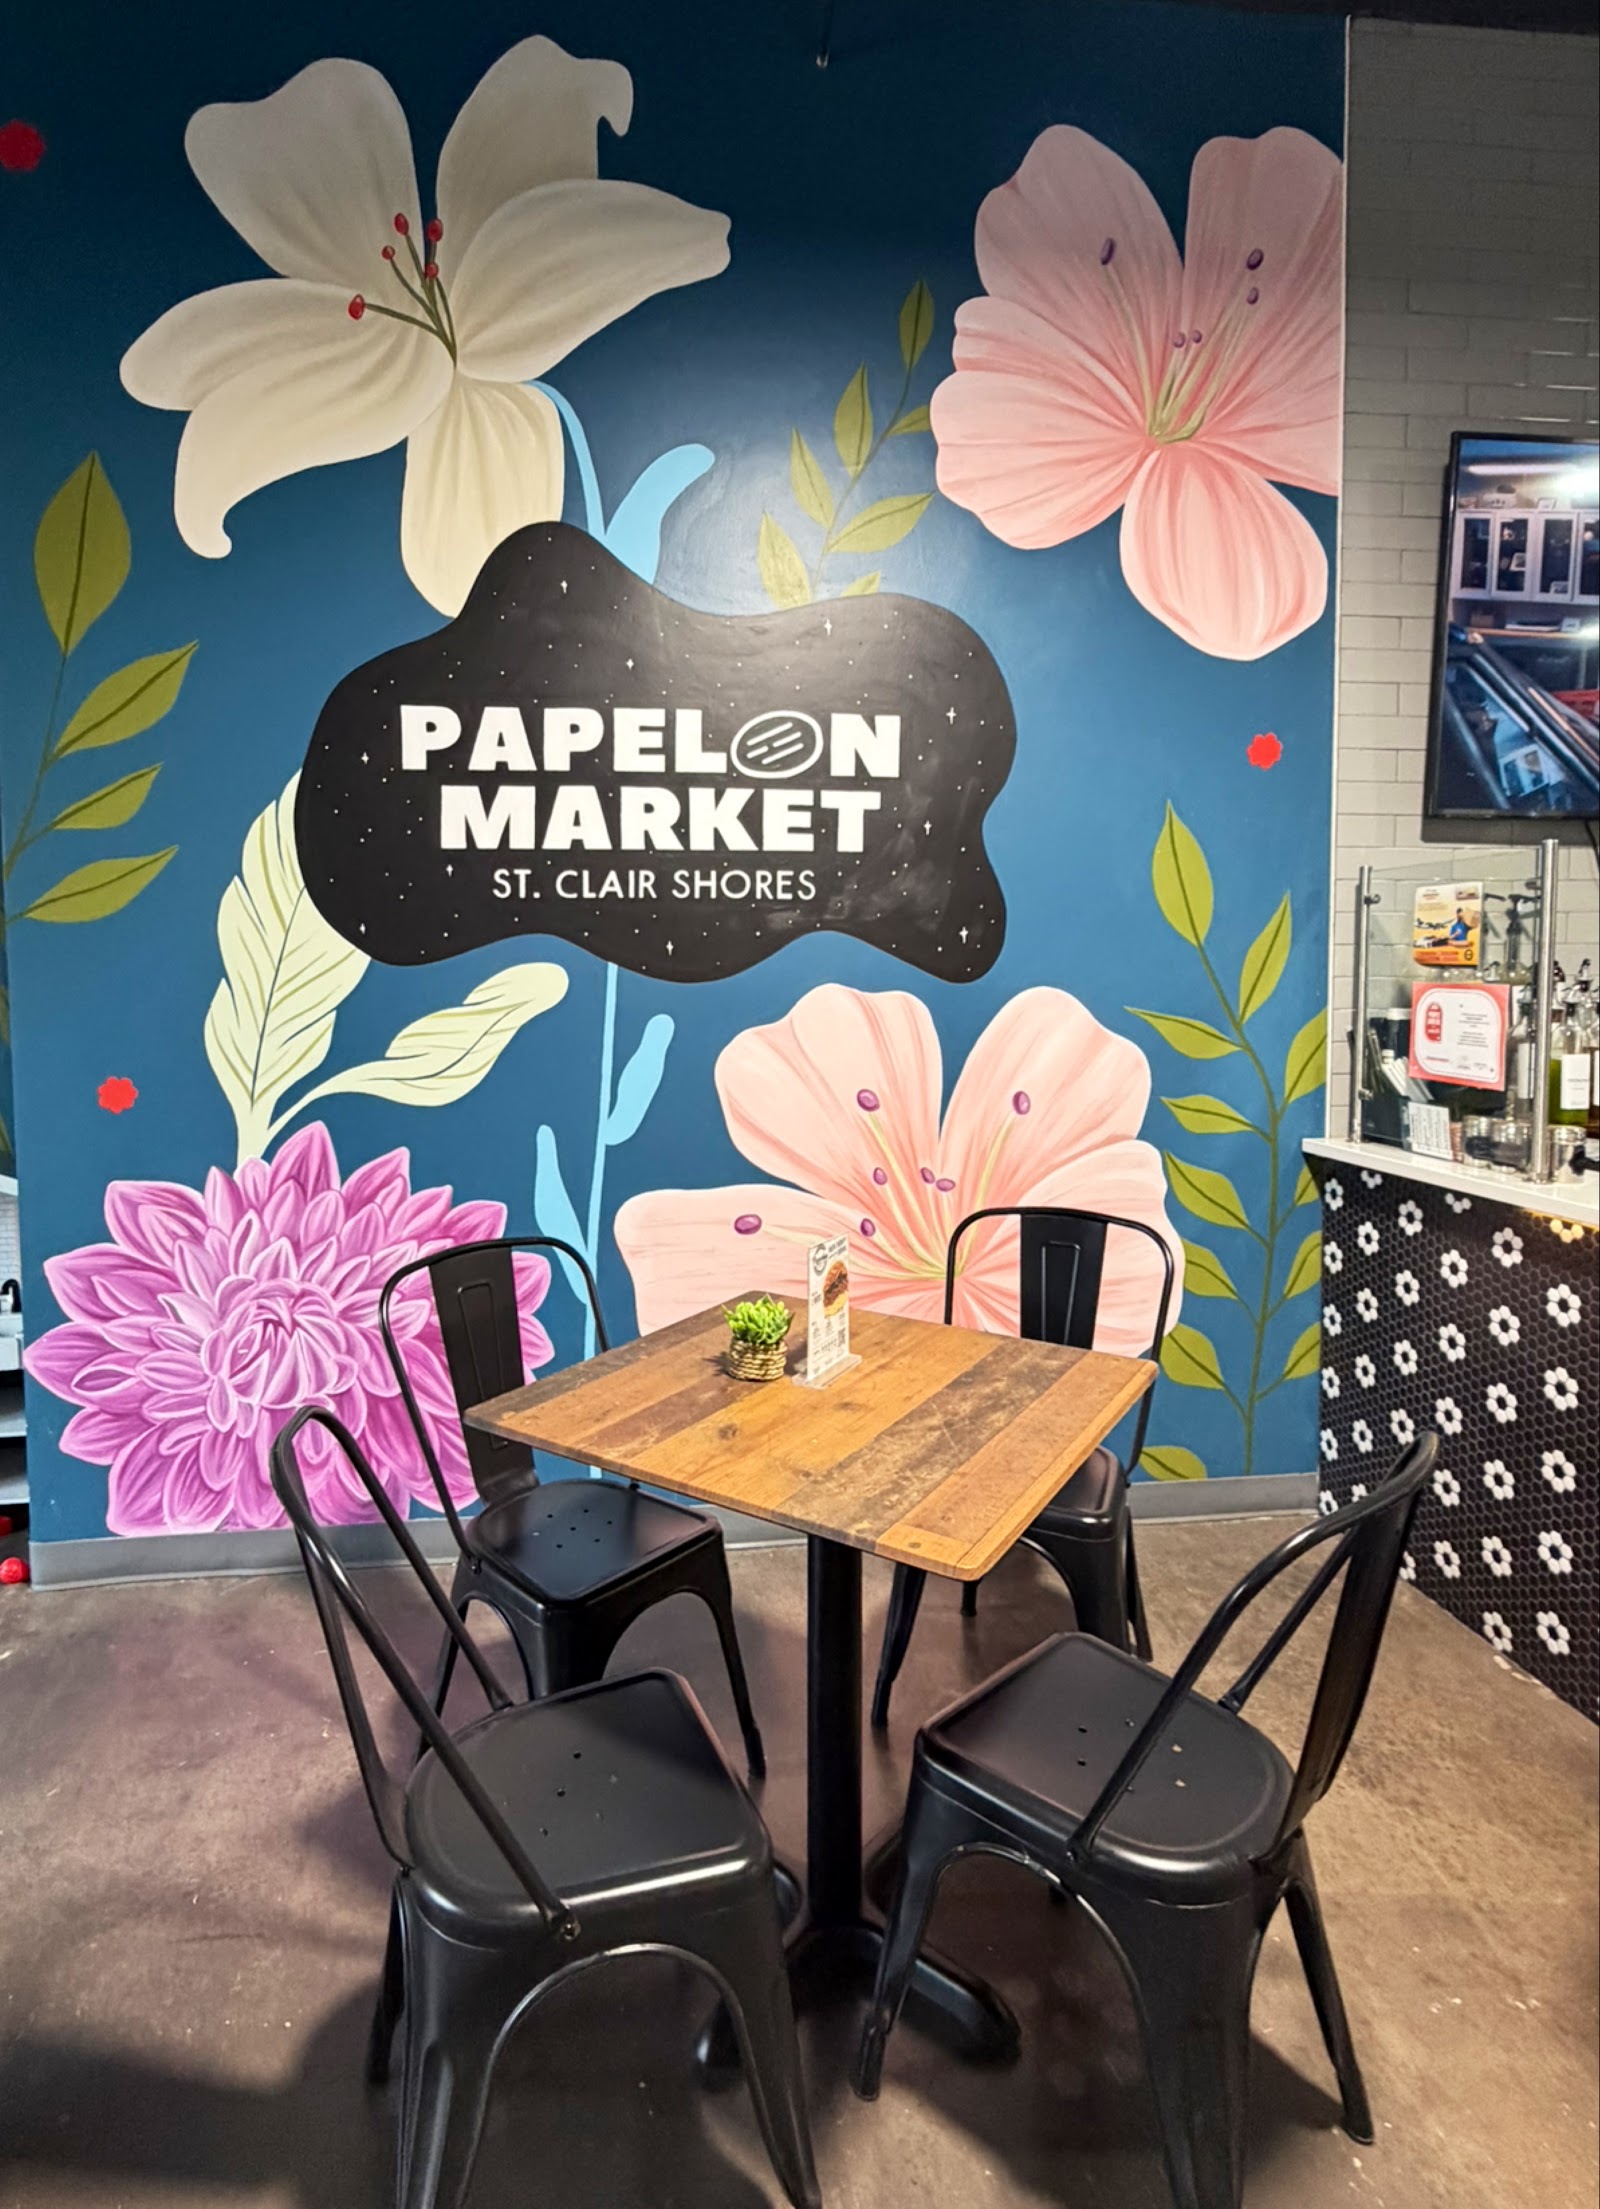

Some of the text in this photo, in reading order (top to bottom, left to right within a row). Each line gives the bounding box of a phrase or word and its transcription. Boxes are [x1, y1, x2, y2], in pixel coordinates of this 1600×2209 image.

[440, 784, 882, 853] MARKET
[492, 868, 816, 901] ST. CLAIR SHORES
